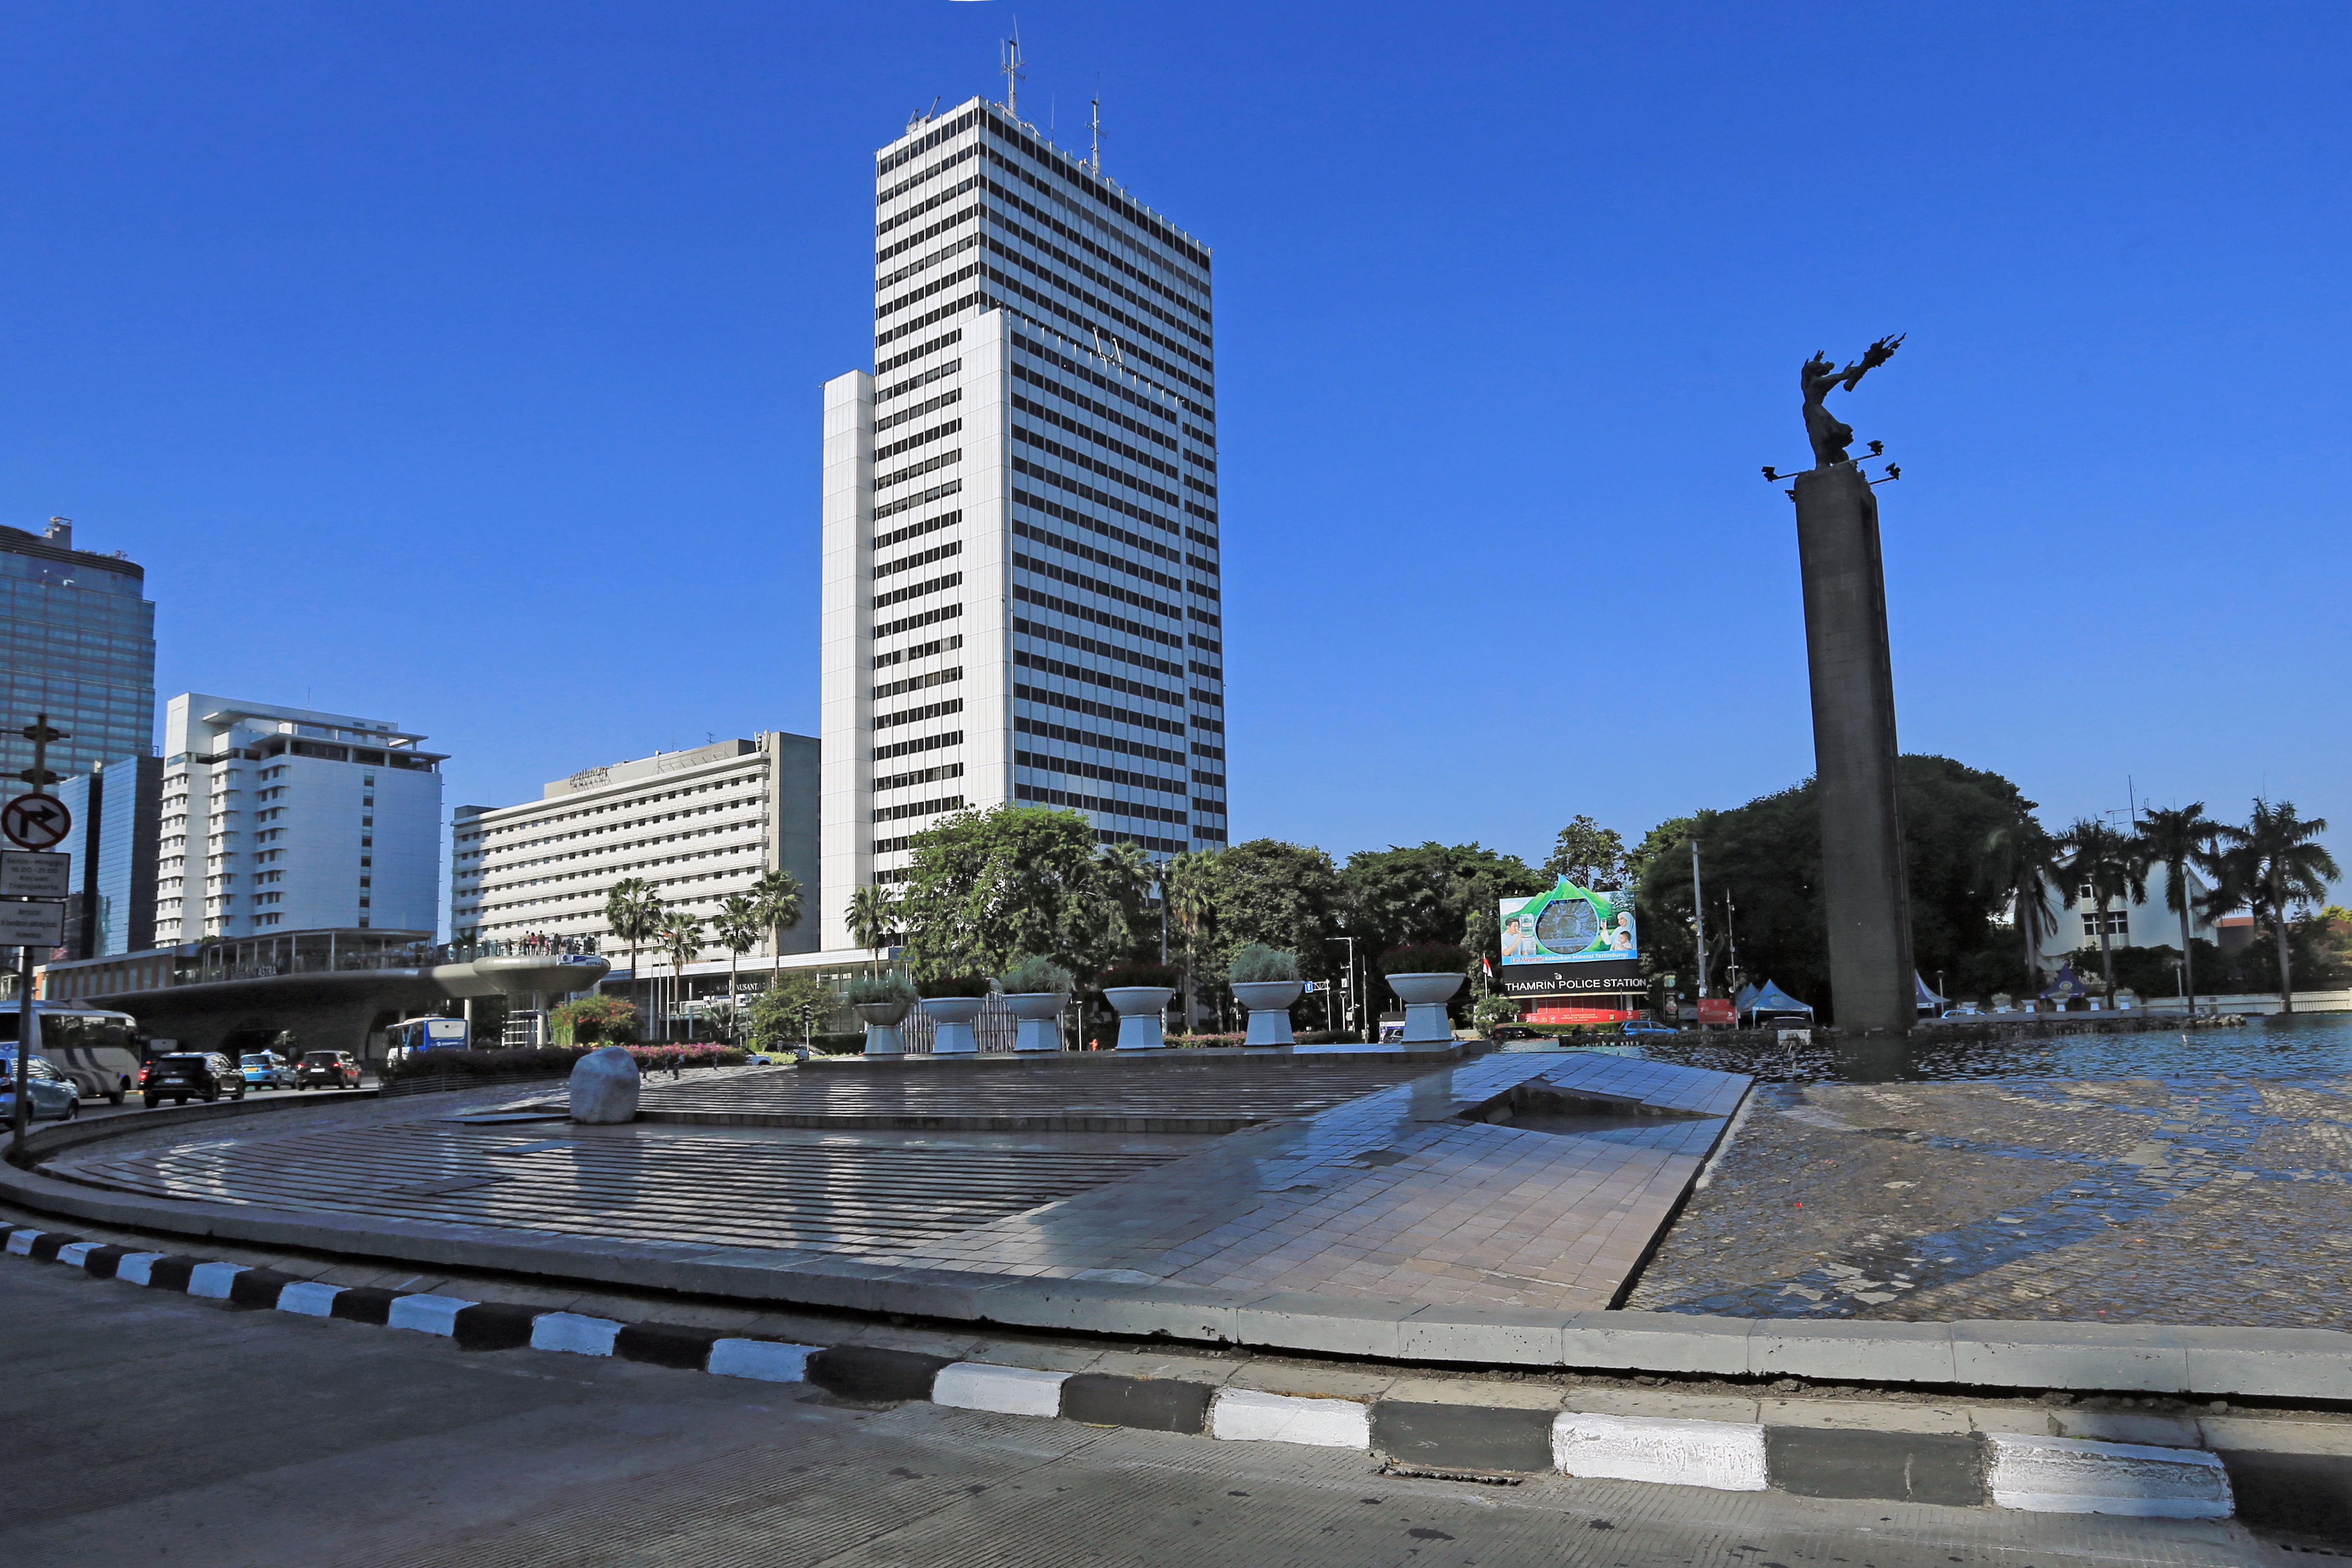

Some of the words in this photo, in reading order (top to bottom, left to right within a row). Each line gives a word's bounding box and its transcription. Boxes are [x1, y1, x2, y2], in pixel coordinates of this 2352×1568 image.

[258, 966, 276, 977] ASTRA
[1505, 981, 1555, 991] THAMRIN
[1558, 979, 1601, 989] POLICE
[1603, 978, 1646, 988] STATION
